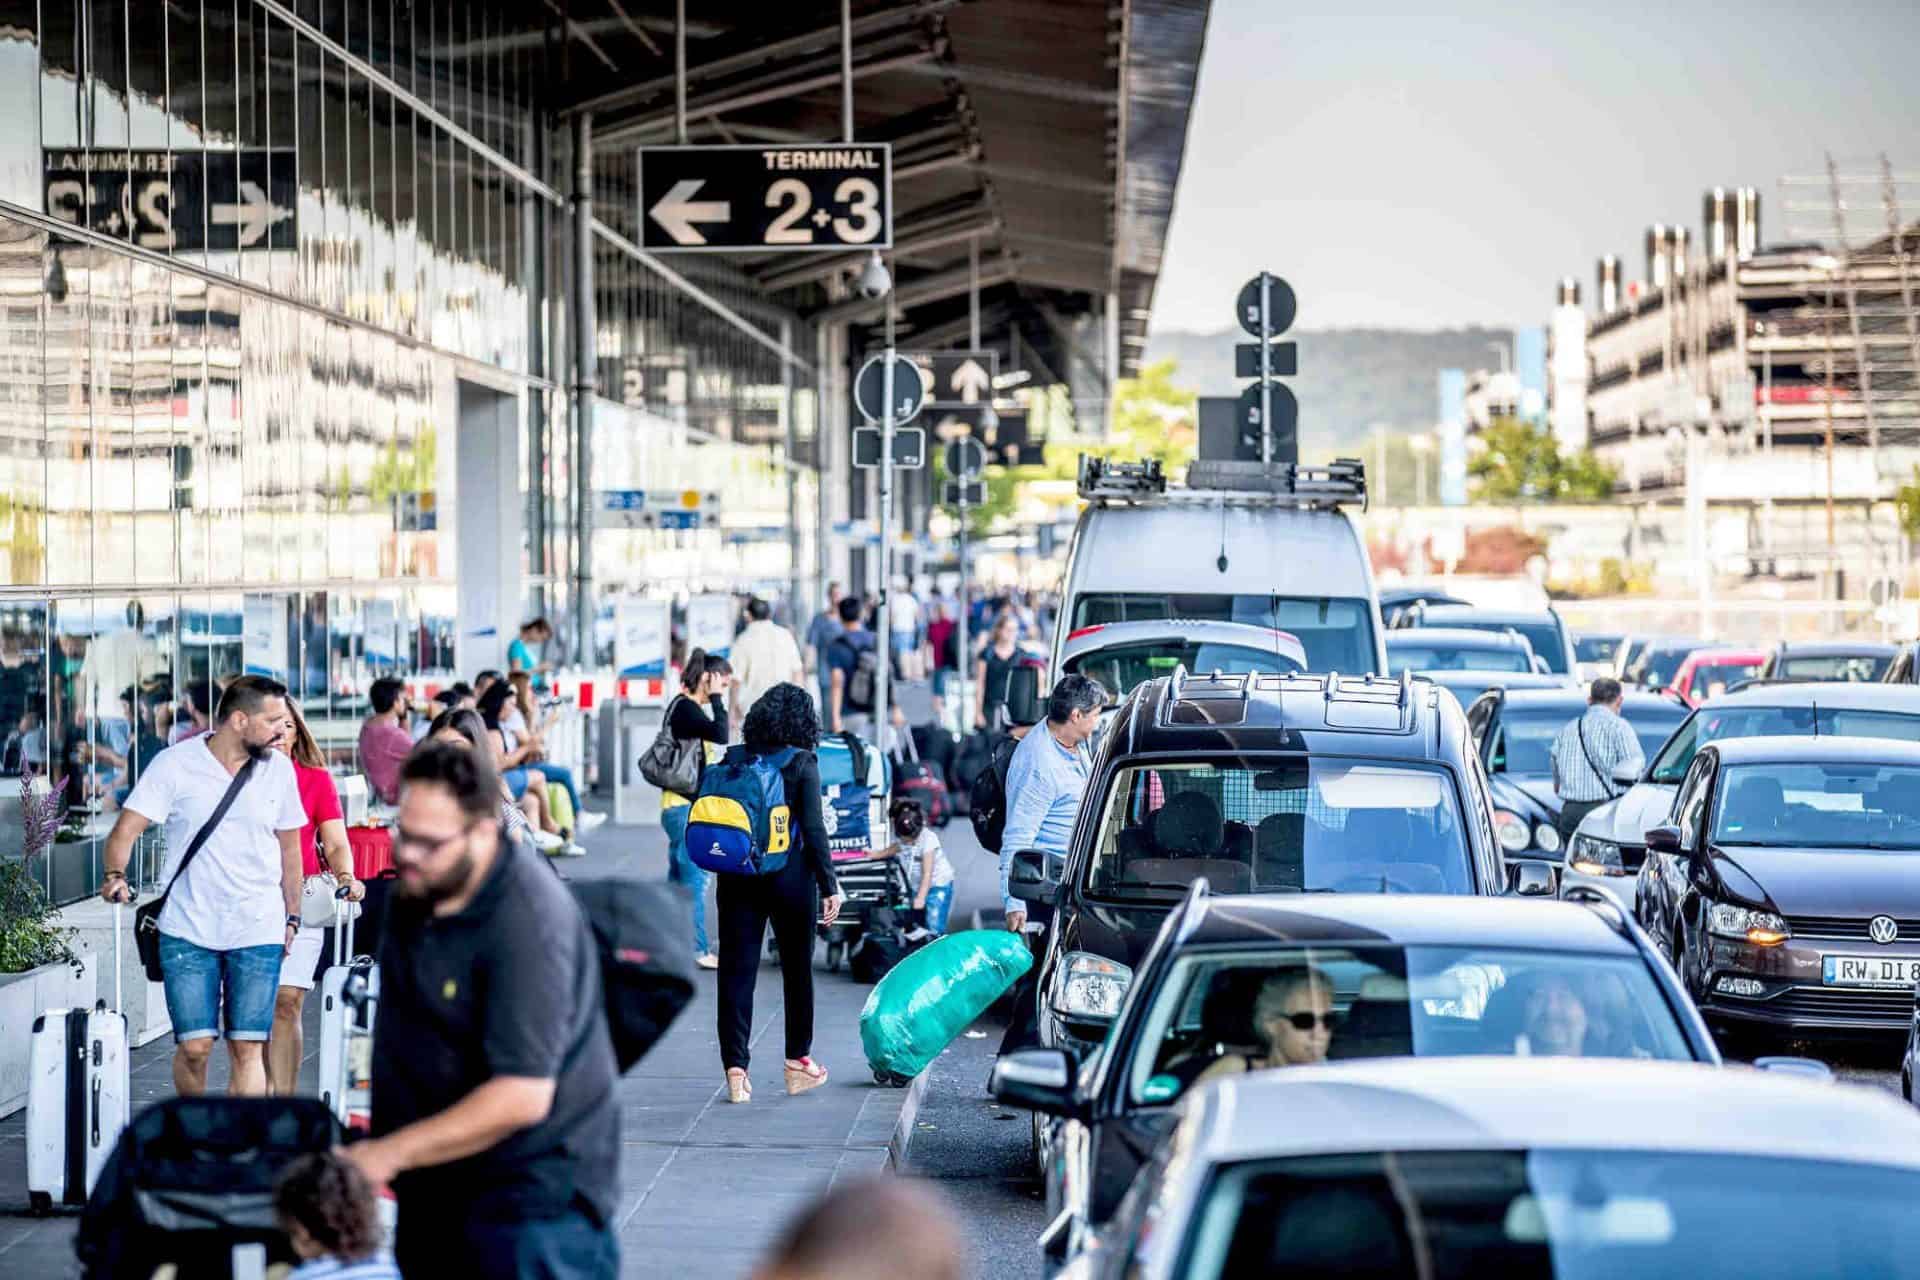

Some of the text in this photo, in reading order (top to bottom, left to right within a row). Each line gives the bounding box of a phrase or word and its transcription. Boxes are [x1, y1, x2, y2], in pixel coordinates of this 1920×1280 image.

[762, 150, 880, 170] TERMINAL
[1842, 961, 1867, 979] RW
[1881, 962, 1905, 981] DI
